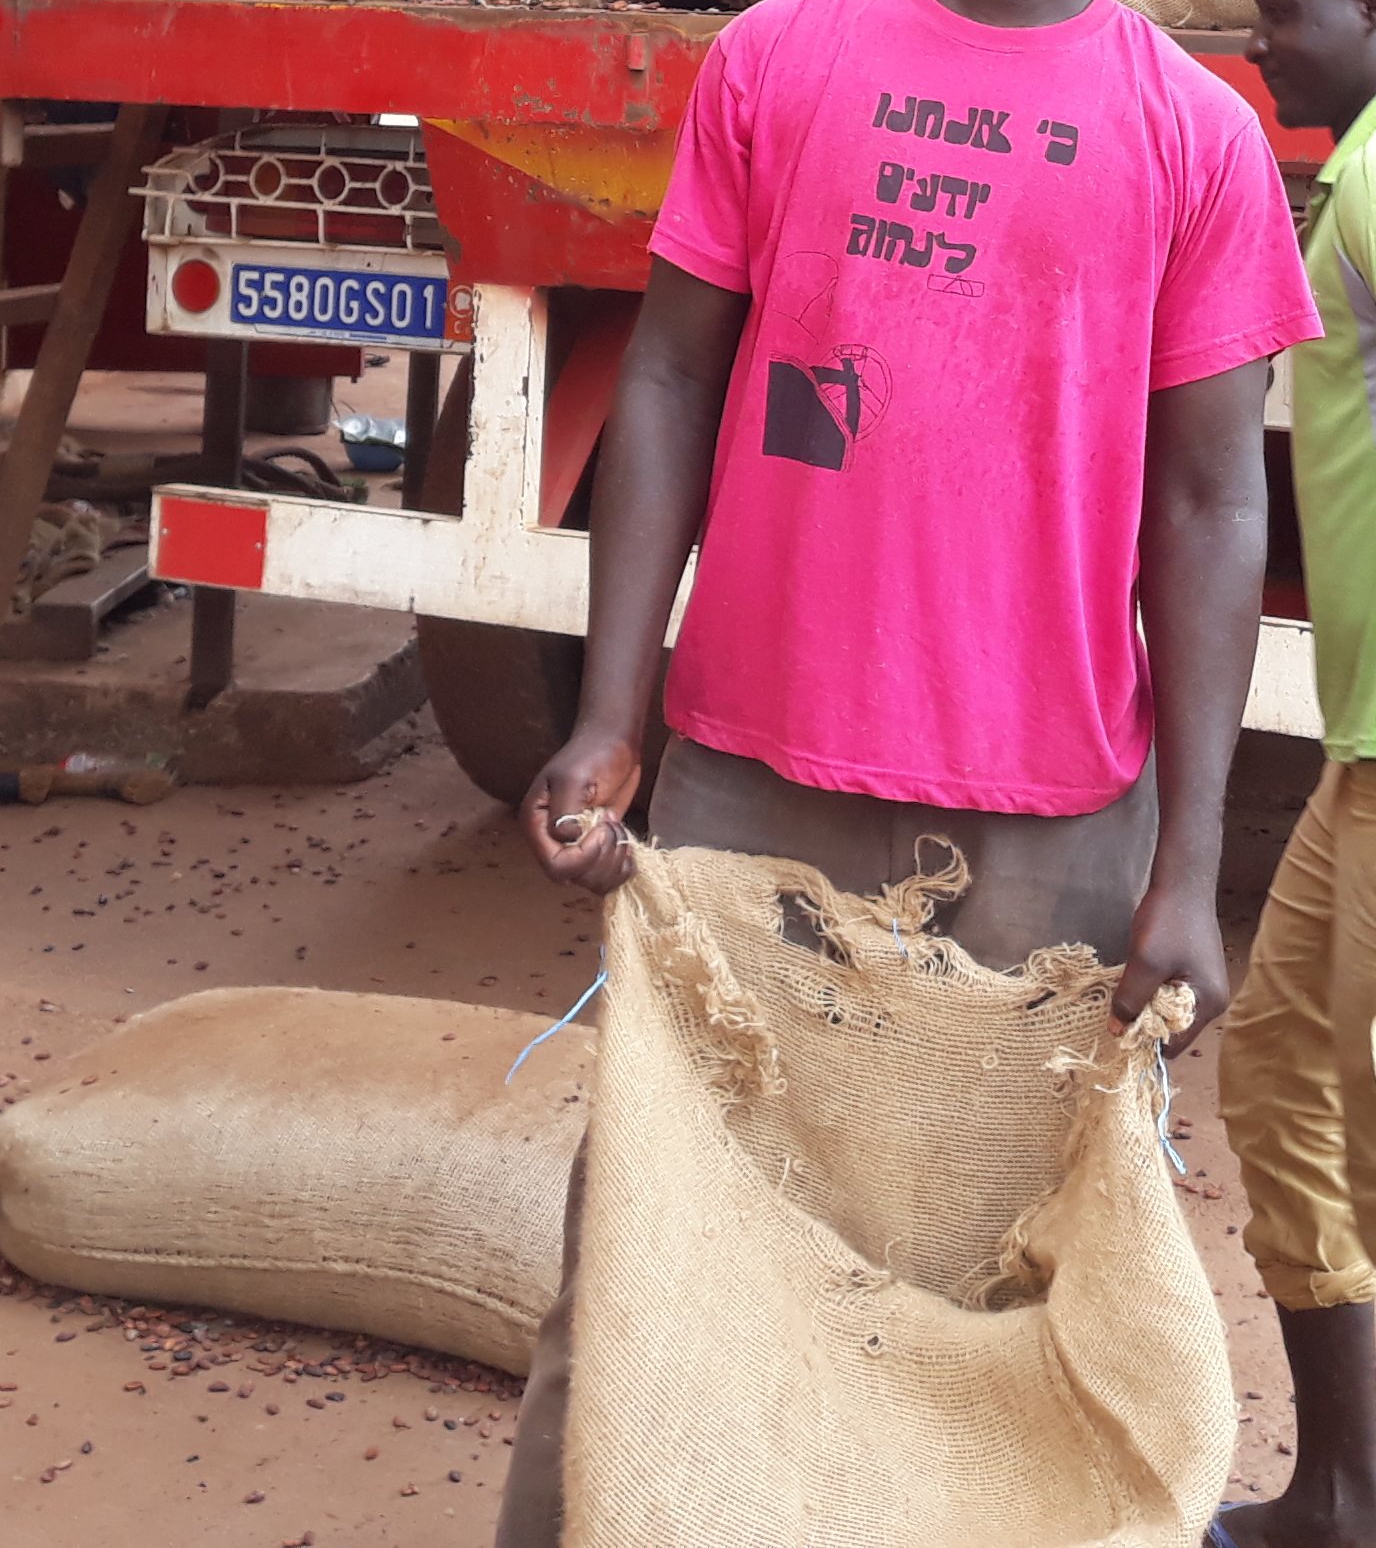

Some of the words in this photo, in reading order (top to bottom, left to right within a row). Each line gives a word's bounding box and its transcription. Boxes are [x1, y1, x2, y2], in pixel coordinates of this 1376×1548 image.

[872, 92, 1012, 153] אנחנו
[1036, 118, 1079, 166] כי
[876, 161, 992, 220] יודעים
[237, 270, 435, 330] 5580GS01
